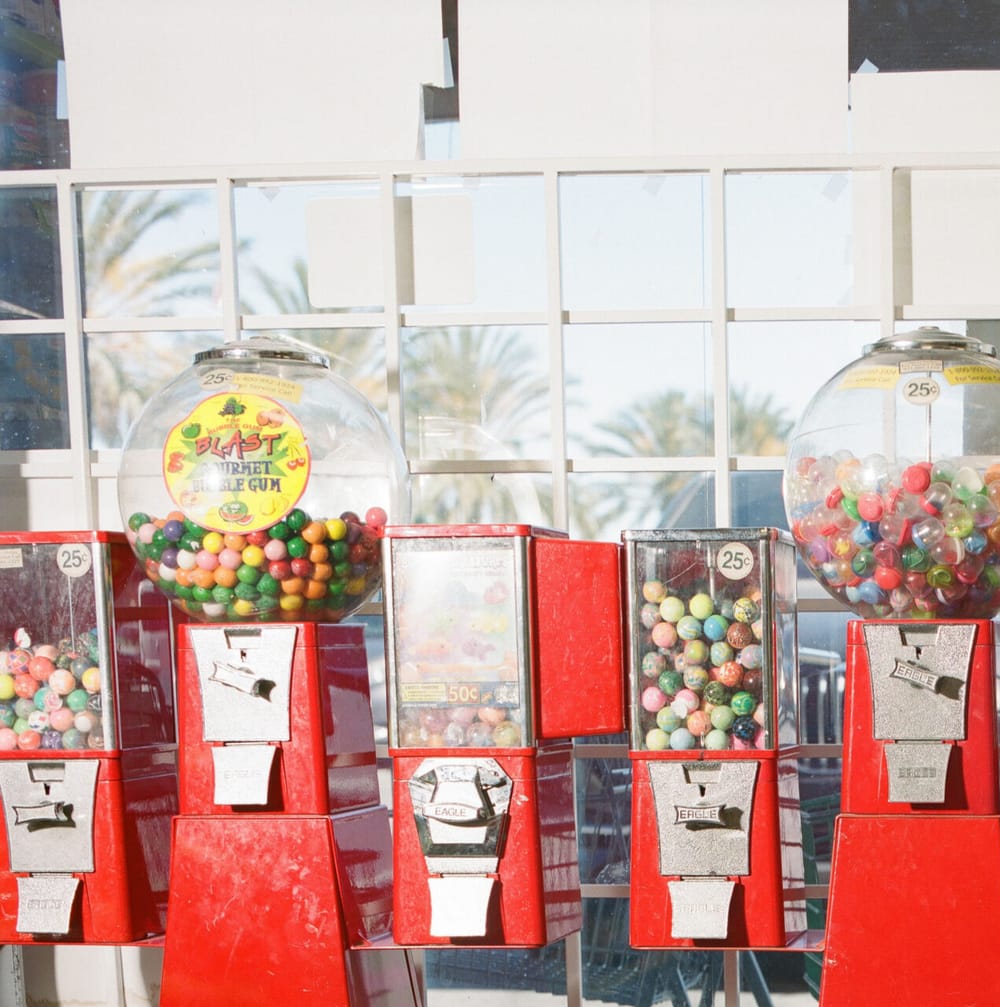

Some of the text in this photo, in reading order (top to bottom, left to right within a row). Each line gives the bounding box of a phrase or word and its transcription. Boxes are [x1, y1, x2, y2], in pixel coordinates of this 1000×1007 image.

[195, 430, 281, 460] BLAST
[202, 461, 272, 475] GURMET
[193, 478, 282, 493] BUBLE GUM
[897, 664, 935, 686] EAGLE
[448, 686, 478, 701] 50¢
[435, 807, 466, 817] EAGLE
[680, 810, 717, 819] EAGLE
